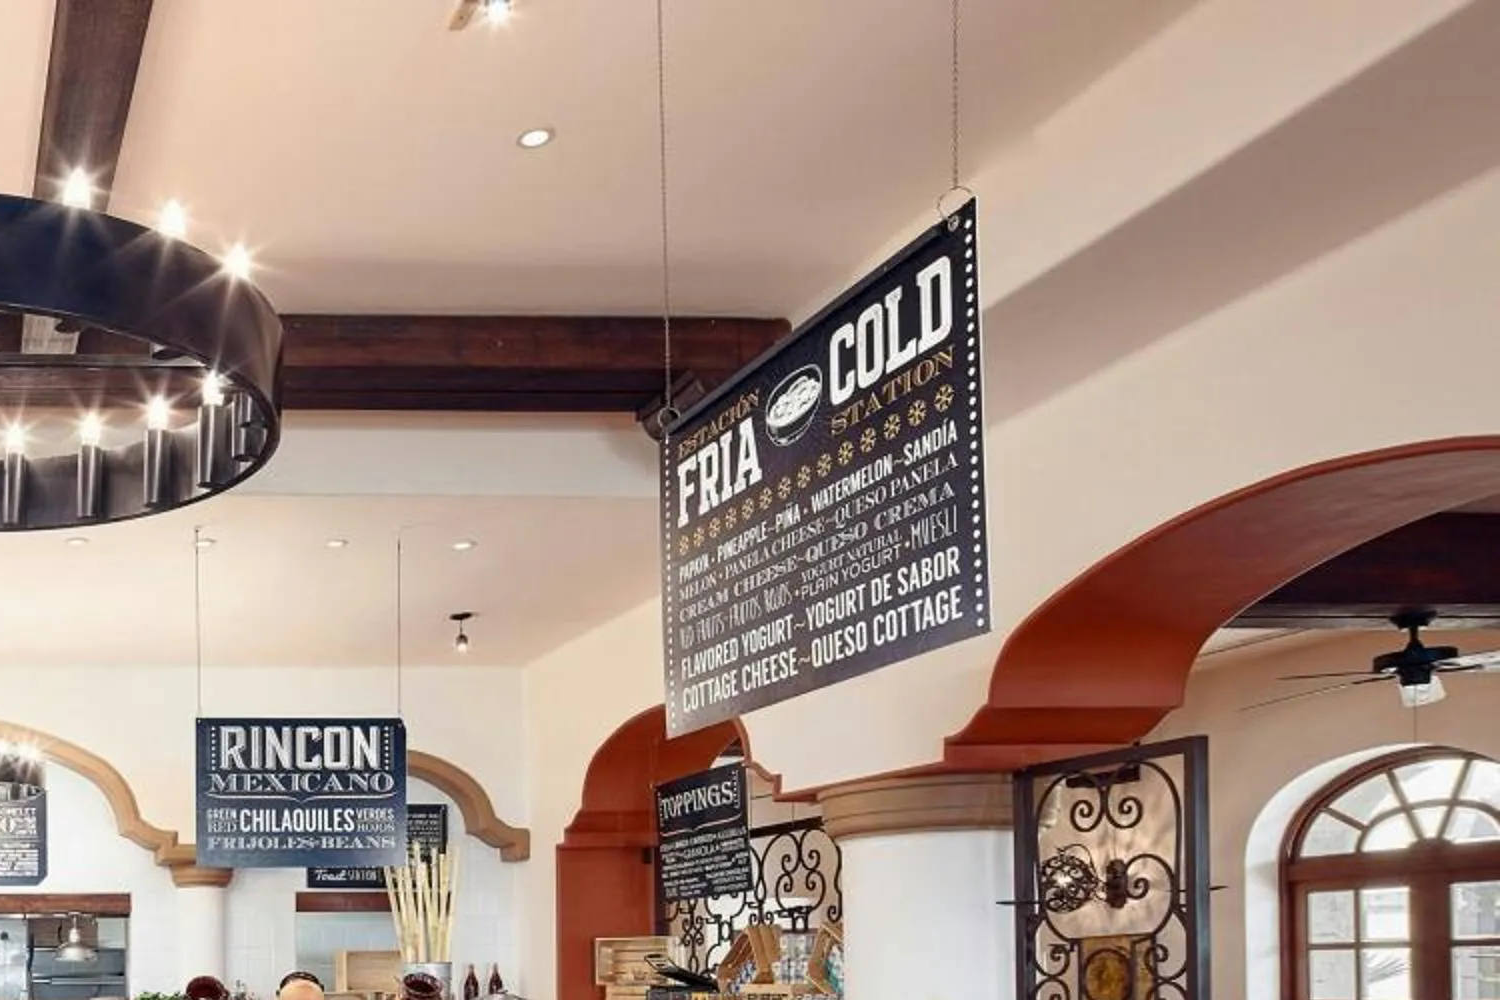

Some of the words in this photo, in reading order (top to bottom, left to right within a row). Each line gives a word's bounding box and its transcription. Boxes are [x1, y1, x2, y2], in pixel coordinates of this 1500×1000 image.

[829, 255, 954, 406] COLD
[830, 345, 956, 436] STATION
[677, 417, 763, 529] FRIA
[717, 521, 768, 563] PINEAPPLE
[775, 502, 801, 533] PIÑA
[811, 453, 893, 514] WATERMELON
[903, 418, 958, 467] SANDÍA
[679, 571, 717, 601] MELON
[725, 546, 770, 580] PANELA
[770, 515, 826, 558] CHEESE
[835, 485, 887, 528] QUESO
[890, 452, 959, 498] PANELA
[679, 588, 729, 623] CREAM
[733, 554, 799, 597] CHEESE
[806, 521, 869, 563] QUESO
[874, 480, 955, 531] CREMA
[910, 504, 959, 550] MUESLI
[801, 553, 845, 584] YOGURT
[848, 529, 902, 564] NATURAL
[801, 572, 840, 600] PLAIN
[841, 543, 902, 584] YOGURT
[681, 637, 739, 681] FLAVORED
[741, 613, 795, 656] YOGURT
[805, 583, 867, 632] YOGURT
[871, 573, 893, 607] DE
[897, 546, 960, 597] SABOR
[683, 669, 739, 713] COTTAGE
[741, 647, 799, 692] CHEESE
[811, 621, 867, 668] QUESO
[873, 585, 963, 646] COTTAGE
[219, 725, 382, 770] RINCON
[206, 772, 395, 793] MEXICANO
[661, 781, 734, 819] TOPPINGS
[207, 808, 237, 821] GREEN
[207, 821, 237, 832] RED
[208, 835, 314, 849] FRIJOLES
[321, 835, 396, 849] BEANS
[239, 807, 355, 833] CHILAQUILES
[355, 808, 395, 821] VERDES
